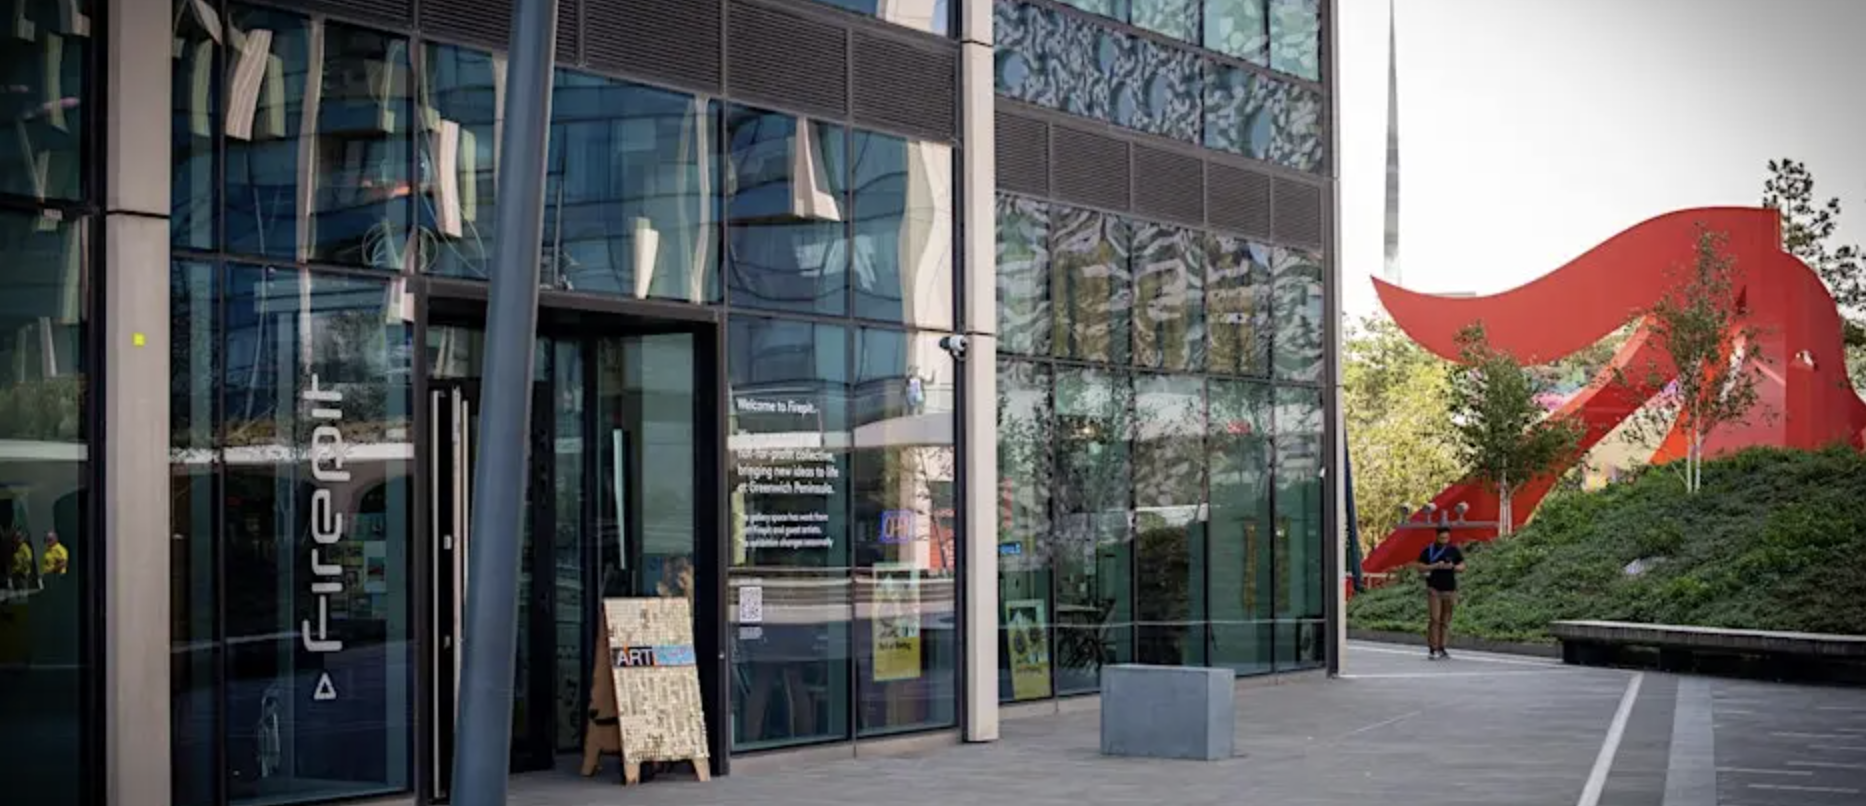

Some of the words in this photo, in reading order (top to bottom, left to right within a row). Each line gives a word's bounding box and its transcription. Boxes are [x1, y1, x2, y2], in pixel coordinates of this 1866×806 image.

[736, 397, 775, 413] Welcome
[777, 401, 786, 413] to
[738, 463, 773, 479] bringing
[774, 468, 791, 477] new
[793, 465, 815, 477] ideas
[816, 467, 825, 477] to
[826, 465, 839, 477] life
[749, 481, 792, 494] Greenwich
[617, 648, 653, 667] ART
